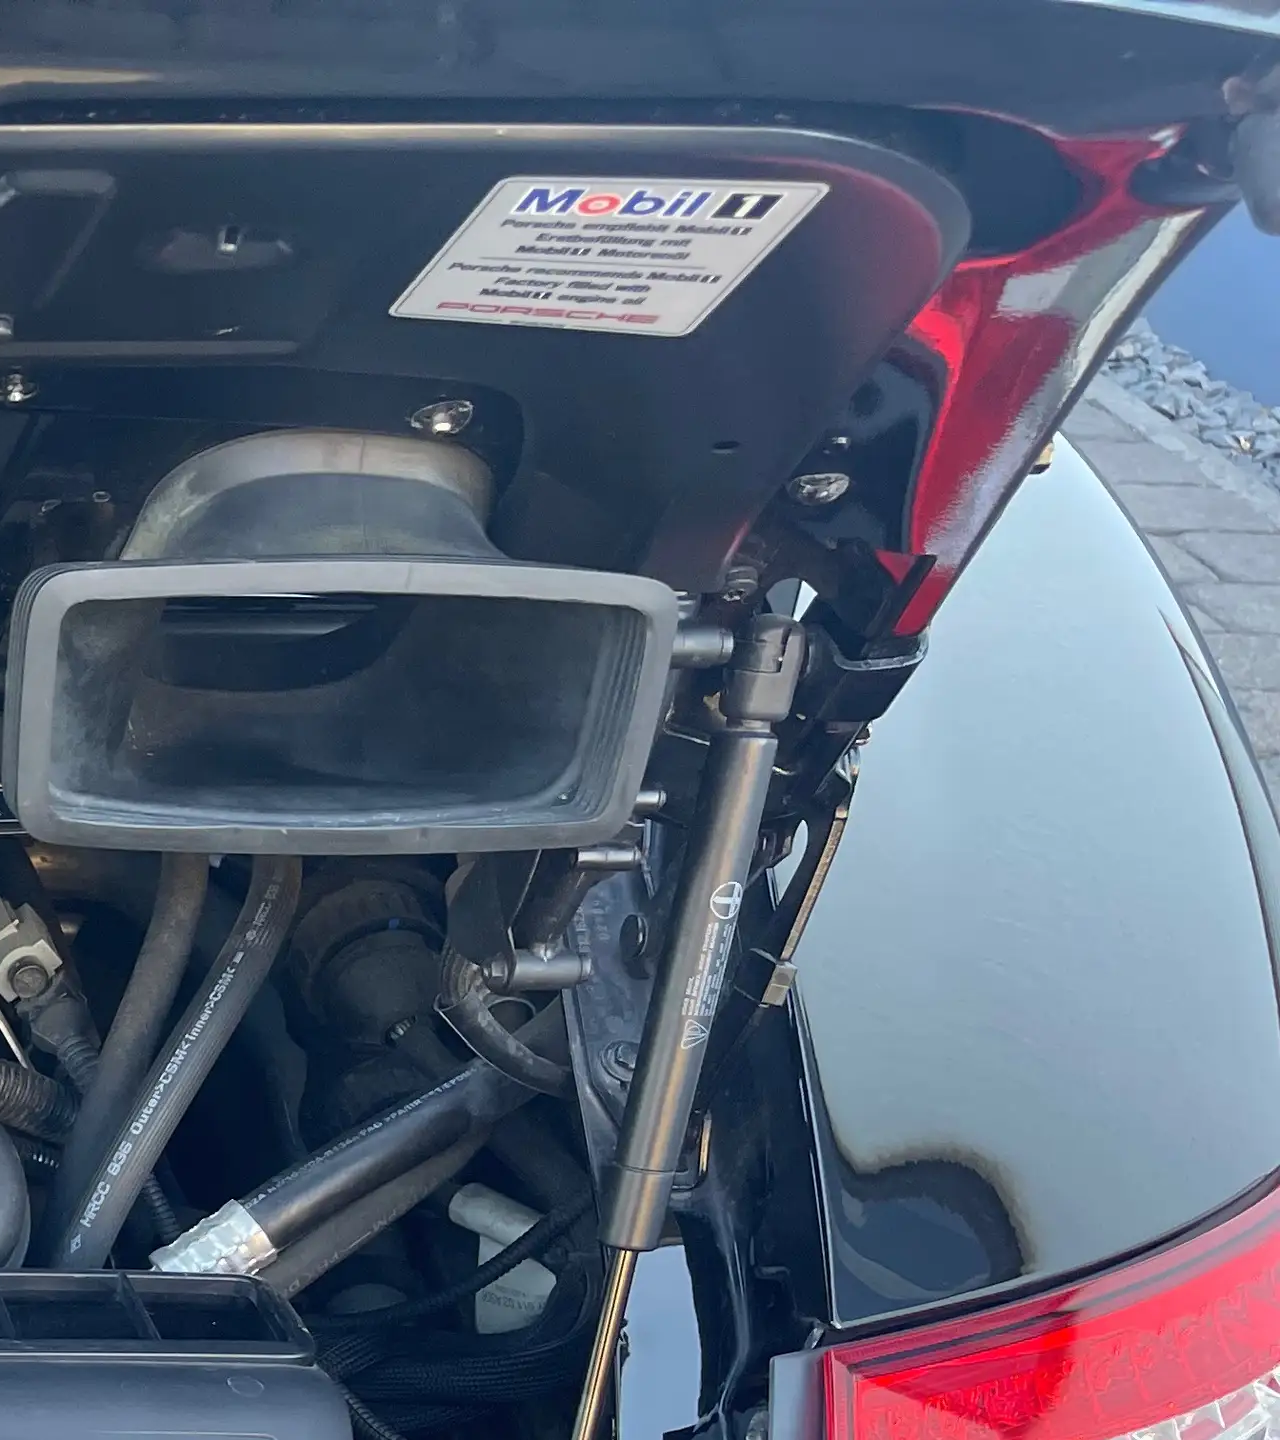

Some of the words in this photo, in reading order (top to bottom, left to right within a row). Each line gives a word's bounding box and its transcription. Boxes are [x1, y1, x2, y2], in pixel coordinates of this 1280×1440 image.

[516, 186, 714, 218] Mobil
[500, 218, 576, 231] Porsche
[582, 222, 670, 233] empfiehlt
[674, 224, 730, 234] Mobil
[659, 237, 693, 247] mit
[515, 244, 569, 255] Mobil
[597, 248, 691, 260] Motorenöl
[447, 261, 522, 273] Porsche
[525, 265, 643, 280] recommends
[646, 271, 701, 282] Mobil
[494, 276, 564, 289] Factory
[567, 280, 614, 291] filled
[615, 283, 652, 292] with
[478, 287, 533, 299] Mobil
[556, 293, 617, 303] engine
[621, 296, 648, 306] oil
[436, 301, 660, 324] PORSCHE
[80, 1180, 112, 1228] MRCC
